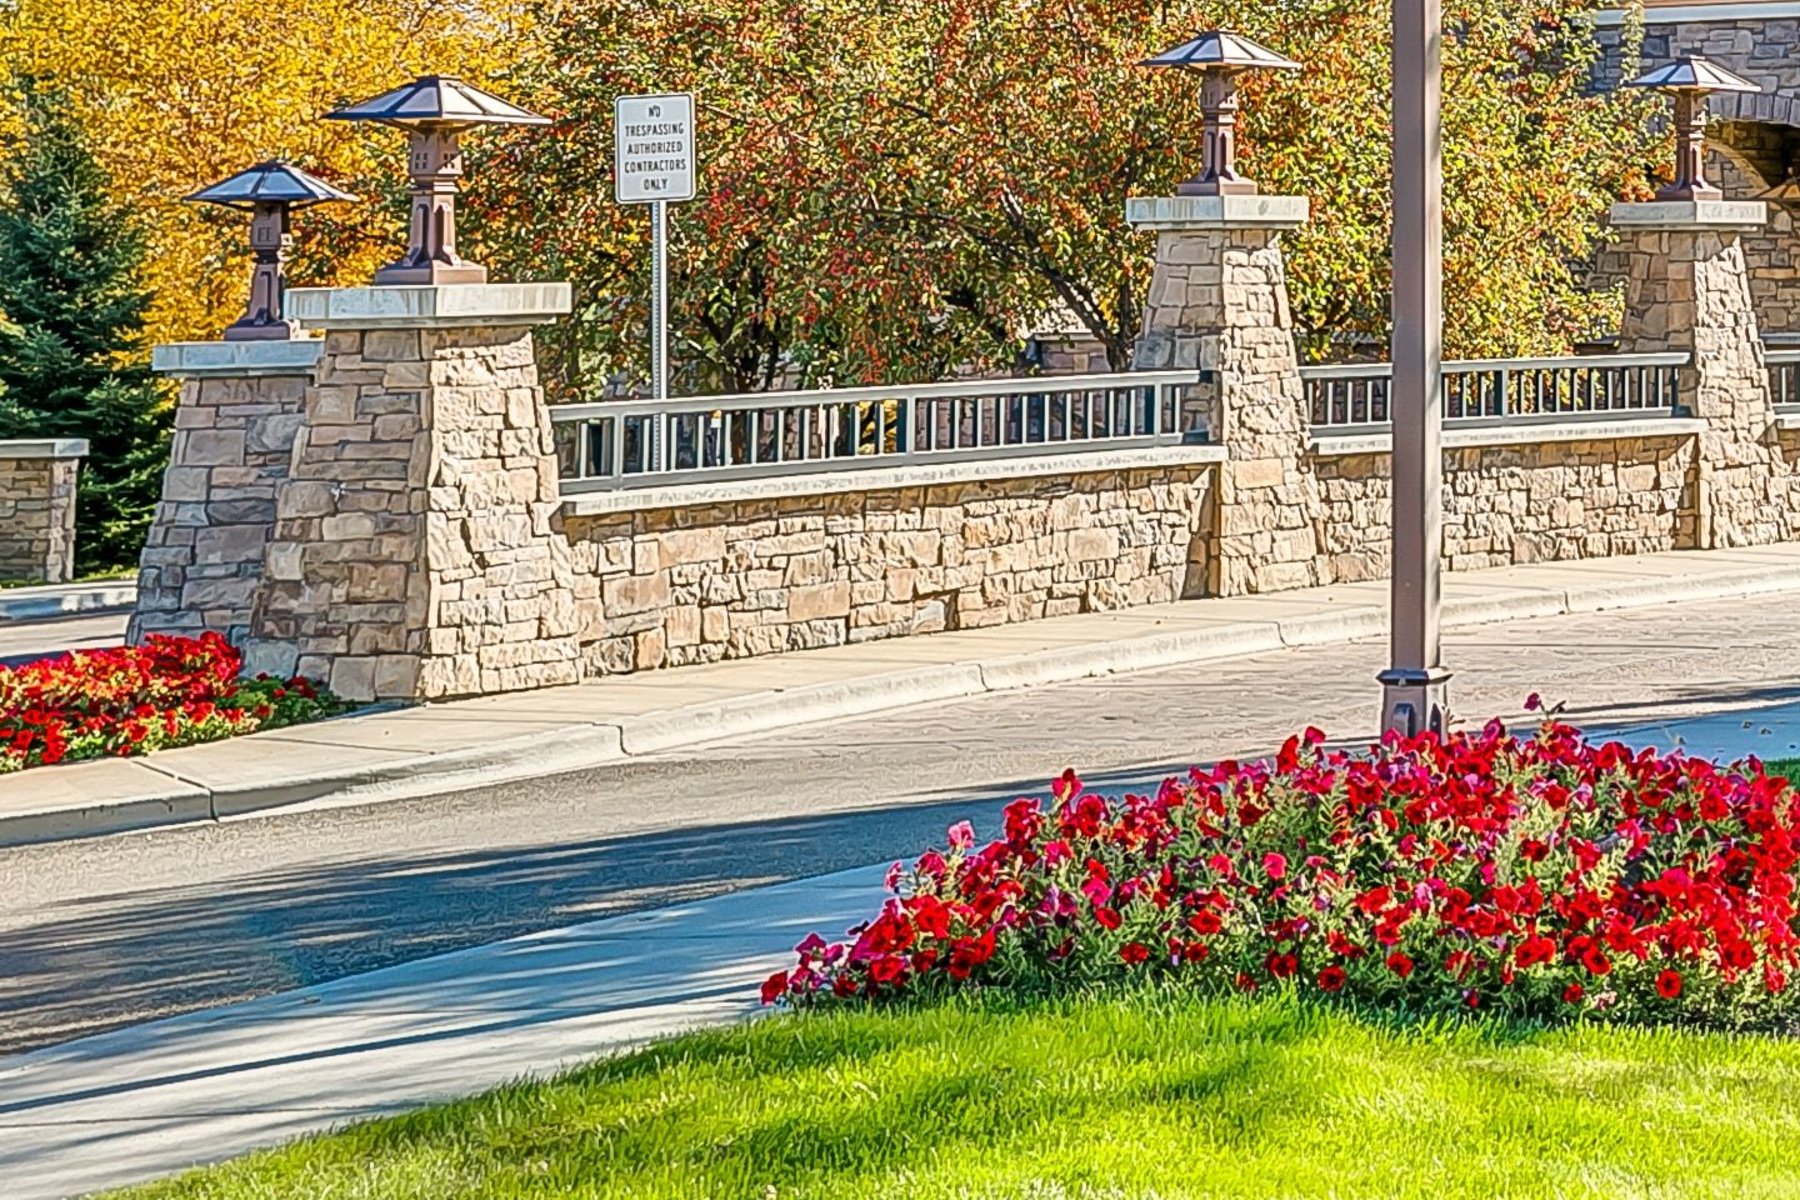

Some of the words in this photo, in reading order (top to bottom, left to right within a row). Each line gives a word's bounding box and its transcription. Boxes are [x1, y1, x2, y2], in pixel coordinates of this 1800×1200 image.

[648, 104, 661, 118] NO
[625, 122, 685, 137] TRESPASSING
[627, 141, 683, 154] AUTHORIZED
[624, 158, 686, 174] CONTRACTORS
[643, 178, 669, 191] ONLY
